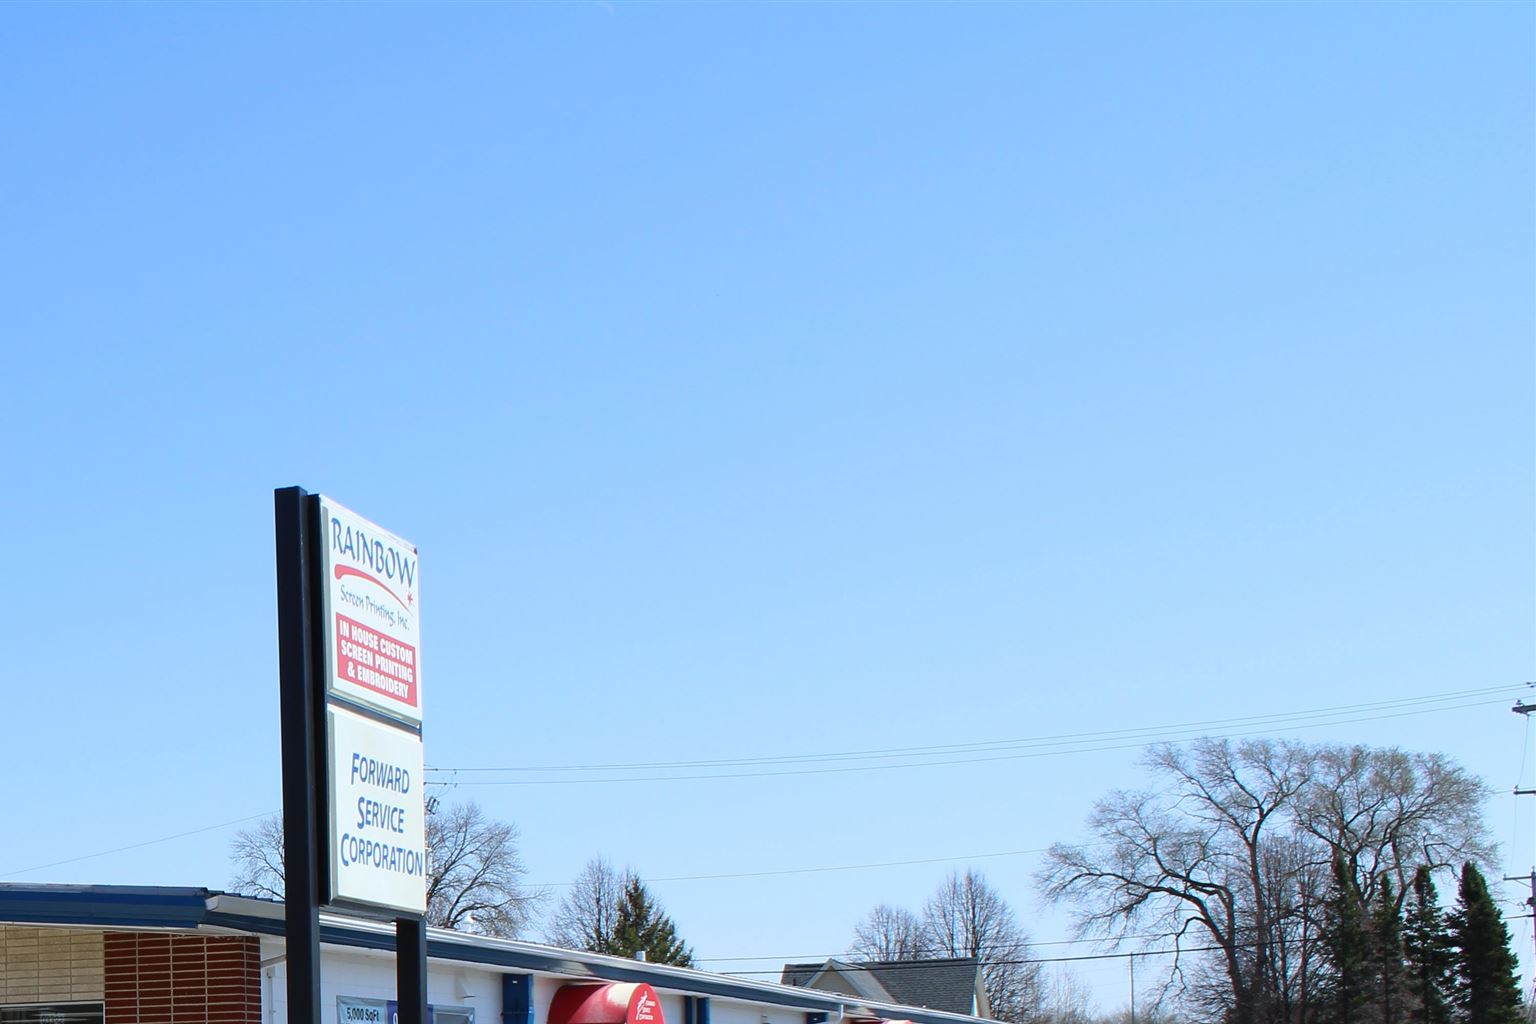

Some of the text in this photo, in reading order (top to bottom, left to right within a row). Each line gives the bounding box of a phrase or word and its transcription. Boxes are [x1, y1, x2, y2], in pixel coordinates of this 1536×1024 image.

[331, 517, 416, 588] RAINBOW
[340, 584, 364, 609] Screen
[340, 619, 413, 666] IN HOUSE CUSTOM
[341, 639, 414, 683] SCREEN PRINTING
[347, 661, 409, 699] & EMBROIDERY
[351, 752, 410, 794] FORWARD
[357, 796, 404, 834] SERVICE
[340, 832, 423, 877] CORPORATION
